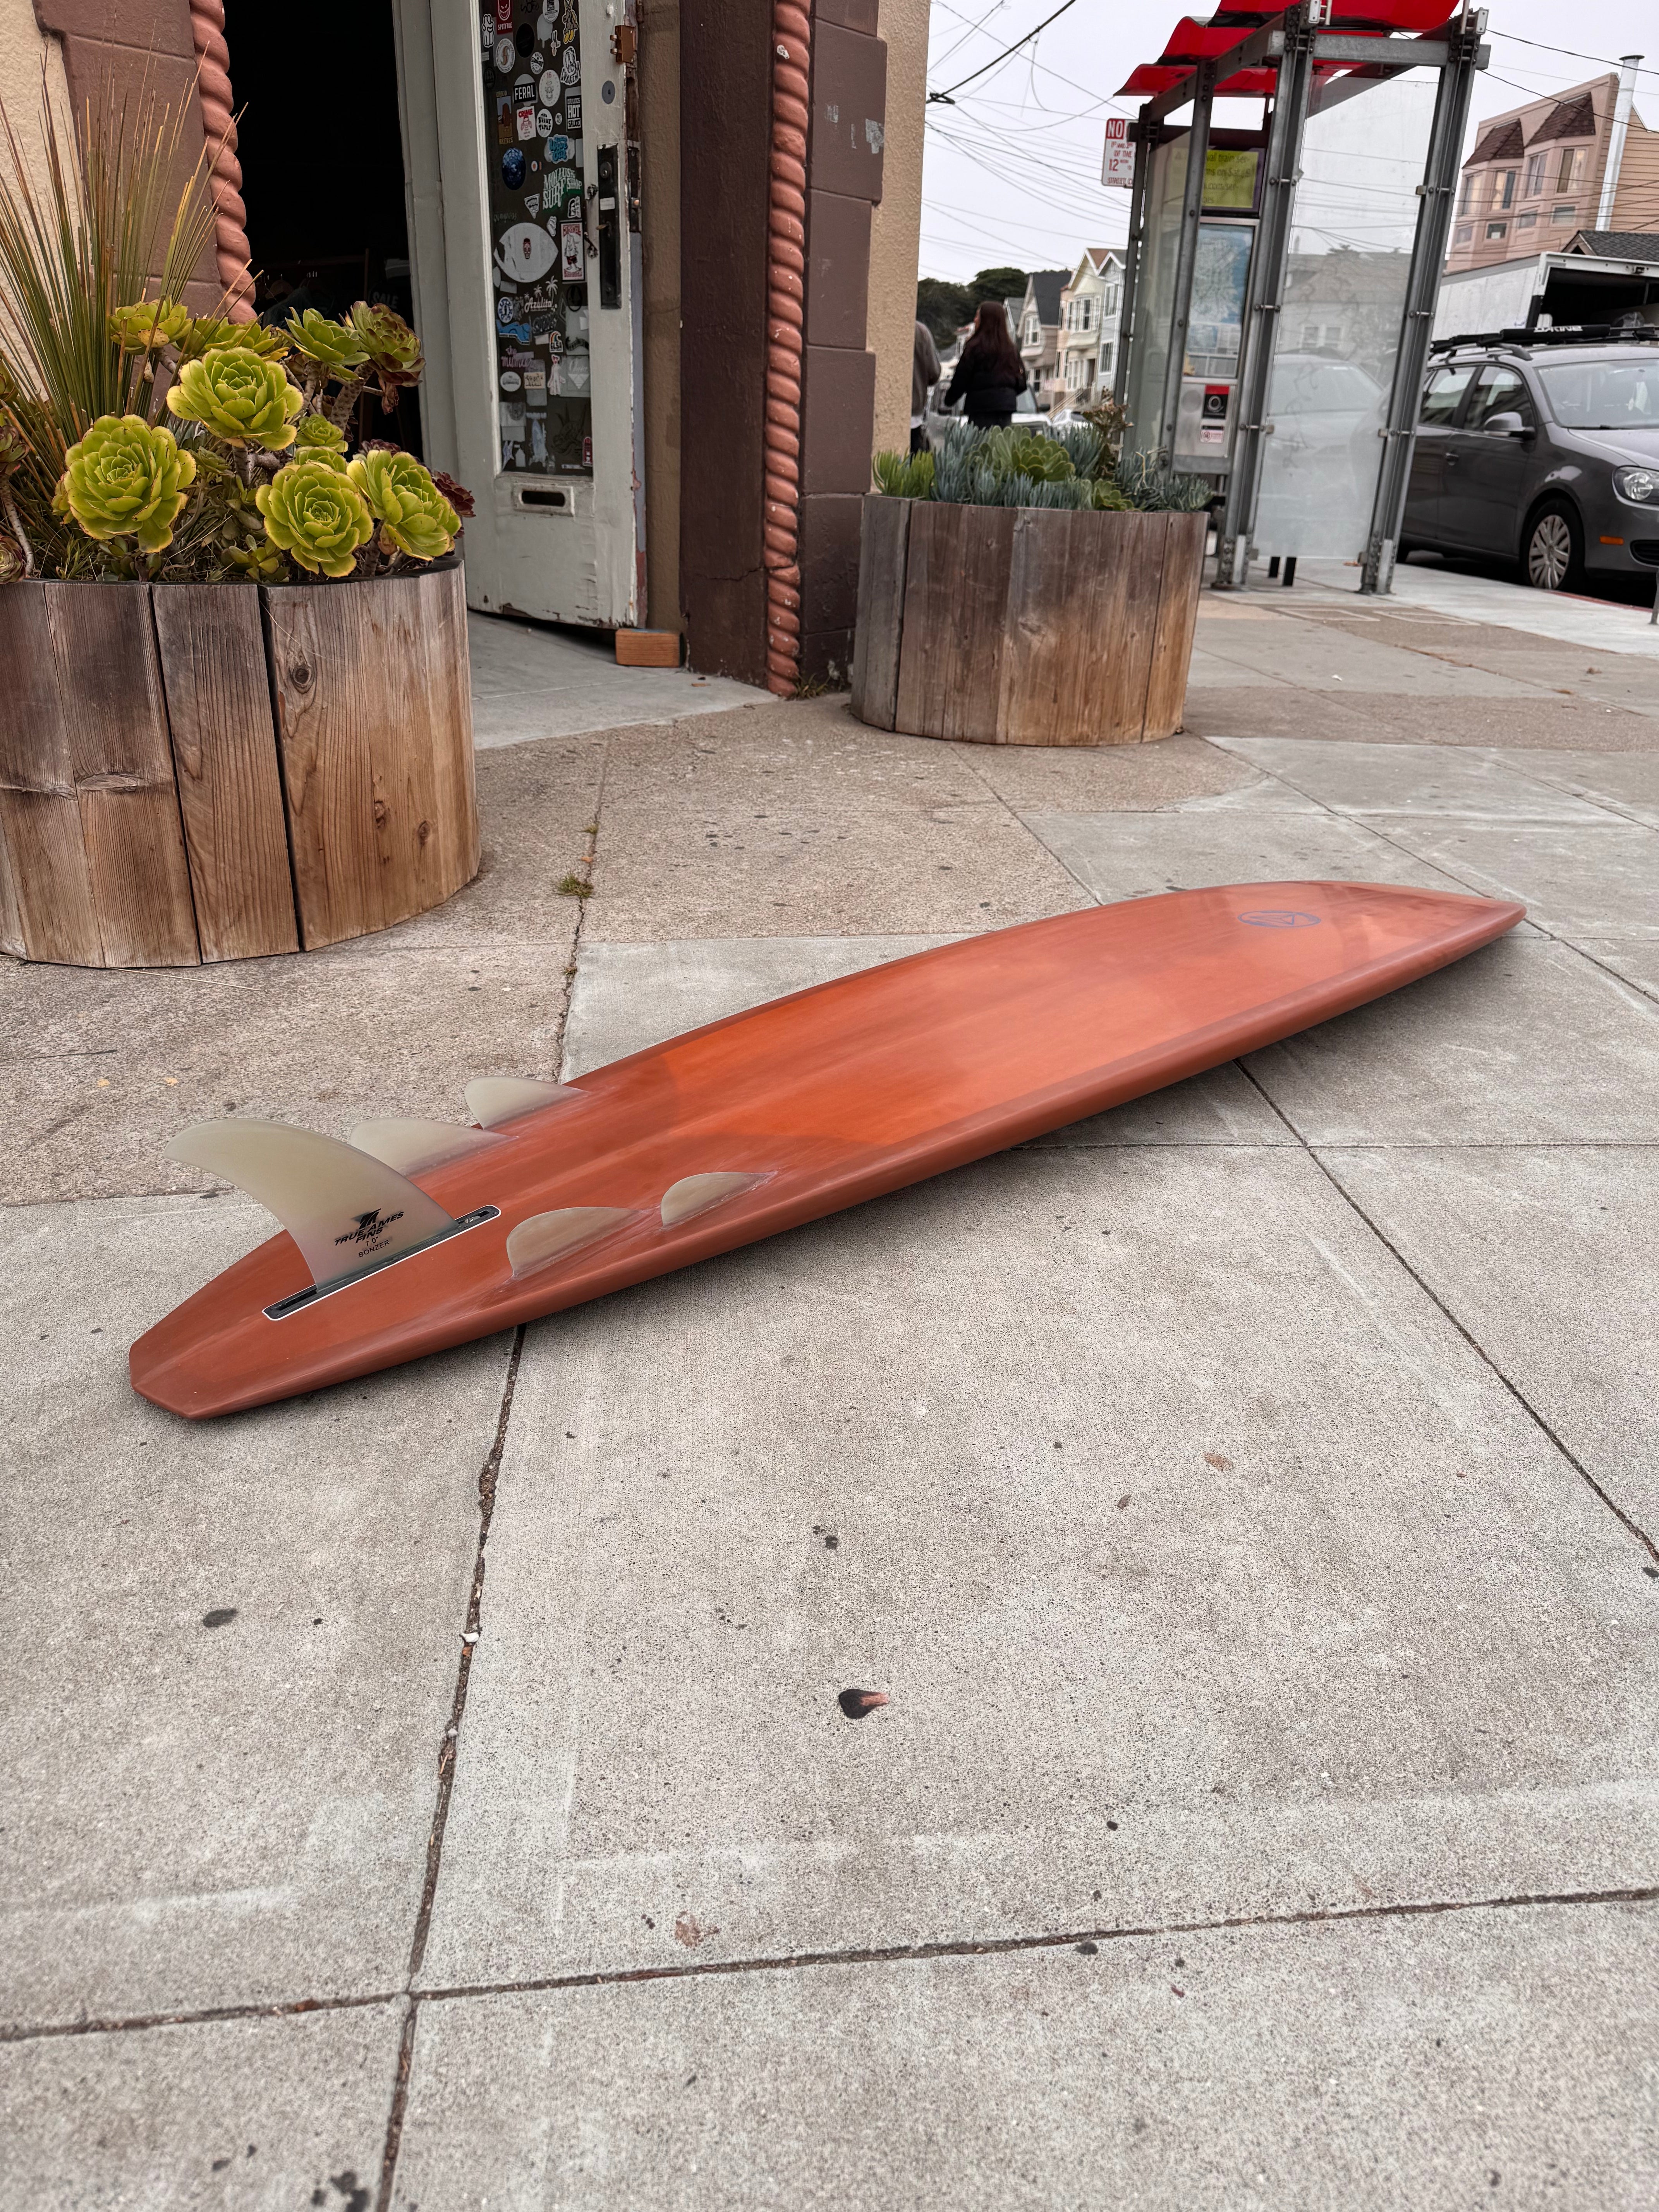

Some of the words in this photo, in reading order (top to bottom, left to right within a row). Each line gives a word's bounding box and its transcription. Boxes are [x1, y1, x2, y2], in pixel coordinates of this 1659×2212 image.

[498, 22, 512, 30] SPITFIRE
[514, 85, 535, 100] FERAL
[519, 108, 533, 118] CRIME
[567, 104, 580, 118] HOT
[1108, 120, 1124, 137] NO
[1109, 159, 1119, 171] 12
[543, 167, 576, 191] MOLLUSK
[543, 178, 566, 210] SURF
[567, 178, 582, 192] SHOP
[371, 292, 398, 309] SALE
[335, 1228, 365, 1246] TRUE
[368, 1211, 404, 1232] AMES
[355, 1226, 383, 1244] FINS
[359, 1240, 390, 1258] BONZER
